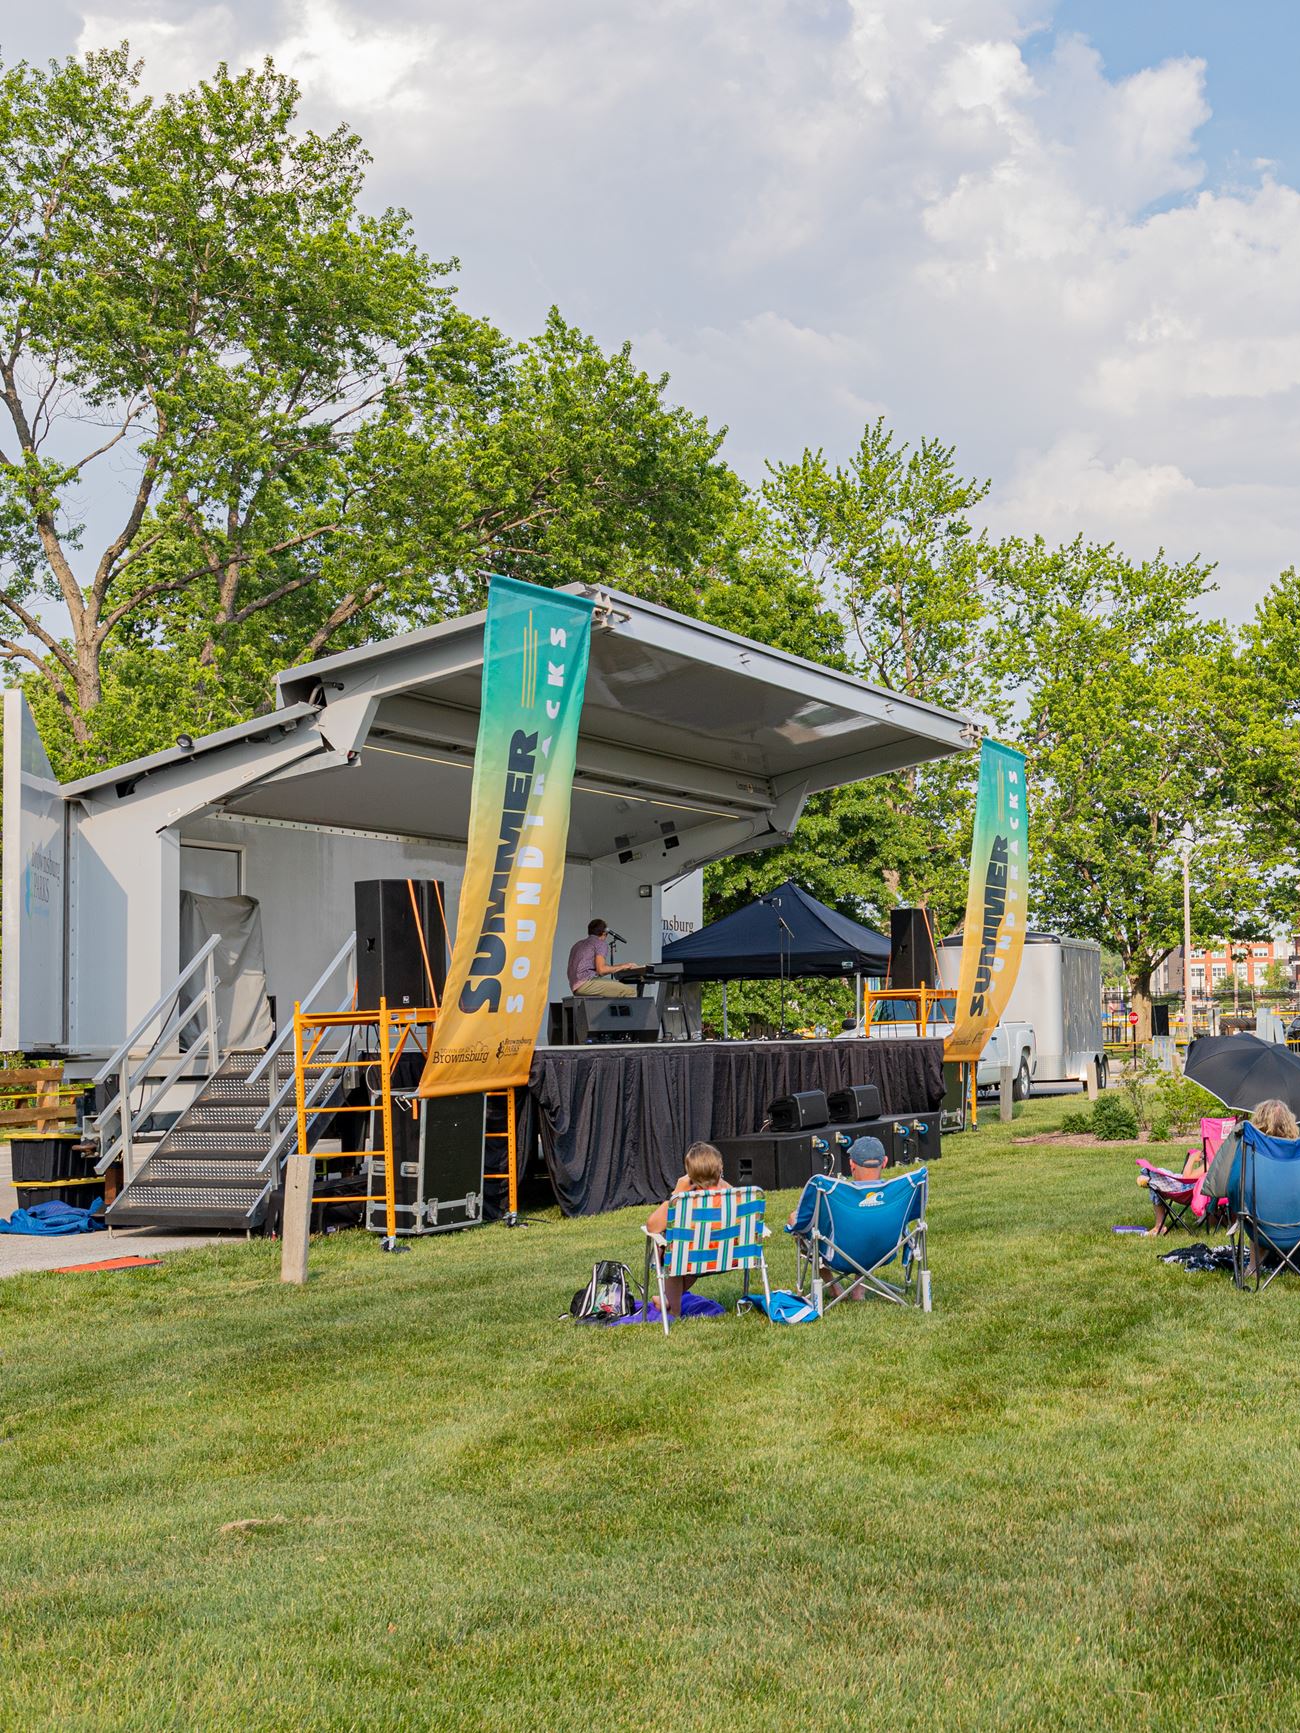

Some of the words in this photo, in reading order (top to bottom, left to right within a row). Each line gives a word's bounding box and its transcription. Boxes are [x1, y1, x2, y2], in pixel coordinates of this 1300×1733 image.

[458, 728, 539, 1014] SUMMER
[970, 834, 1008, 1018] SUMMER
[432, 1050, 490, 1063] Brownsburg
